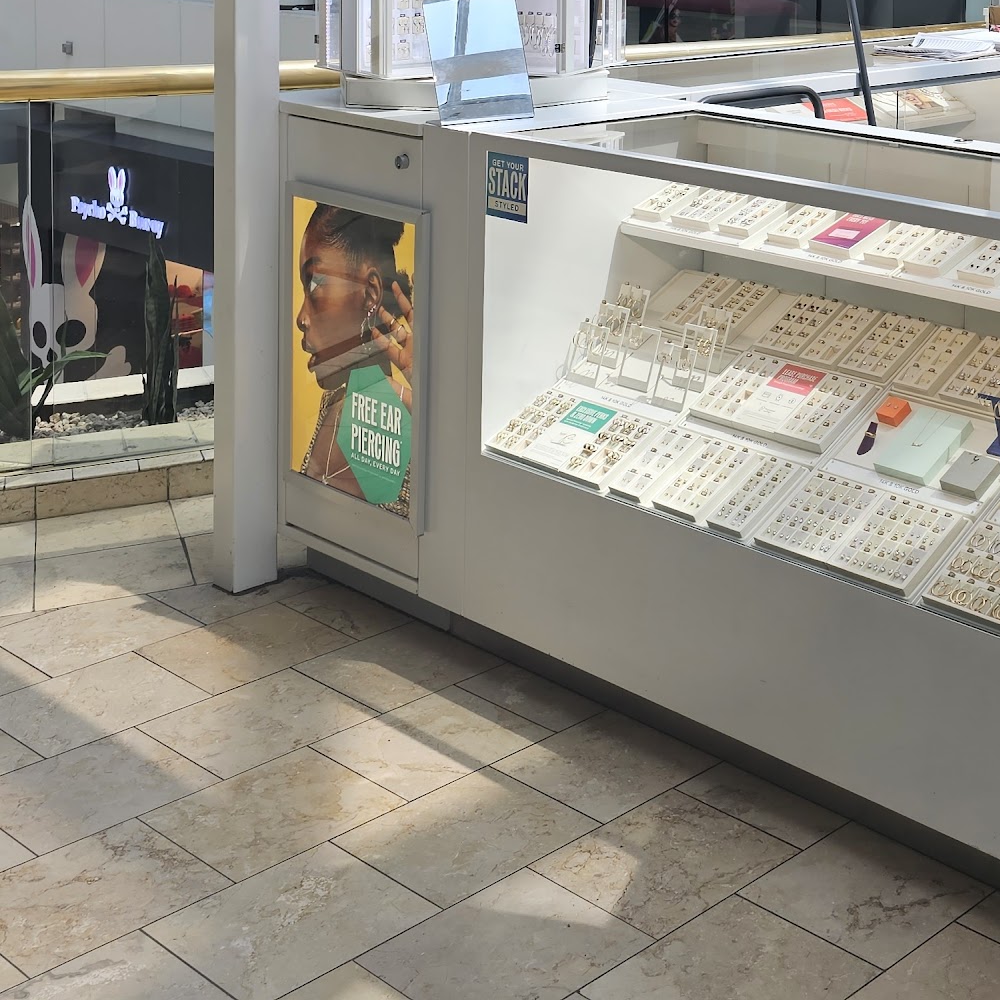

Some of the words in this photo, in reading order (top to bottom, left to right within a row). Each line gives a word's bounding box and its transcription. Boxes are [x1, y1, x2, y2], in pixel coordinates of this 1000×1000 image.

[492, 159, 506, 168] GET
[506, 161, 525, 172] YOUR
[488, 166, 528, 202] STACK
[494, 200, 520, 212] STYLED
[352, 392, 378, 427] FREE
[381, 402, 402, 436] EAR
[351, 423, 401, 467] PIERCING
[351, 452, 361, 462] ALL
[361, 455, 373, 467] DAY,
[372, 460, 390, 474] EVERY
[389, 466, 401, 477] DAY
[903, 485, 920, 495] GOLD
